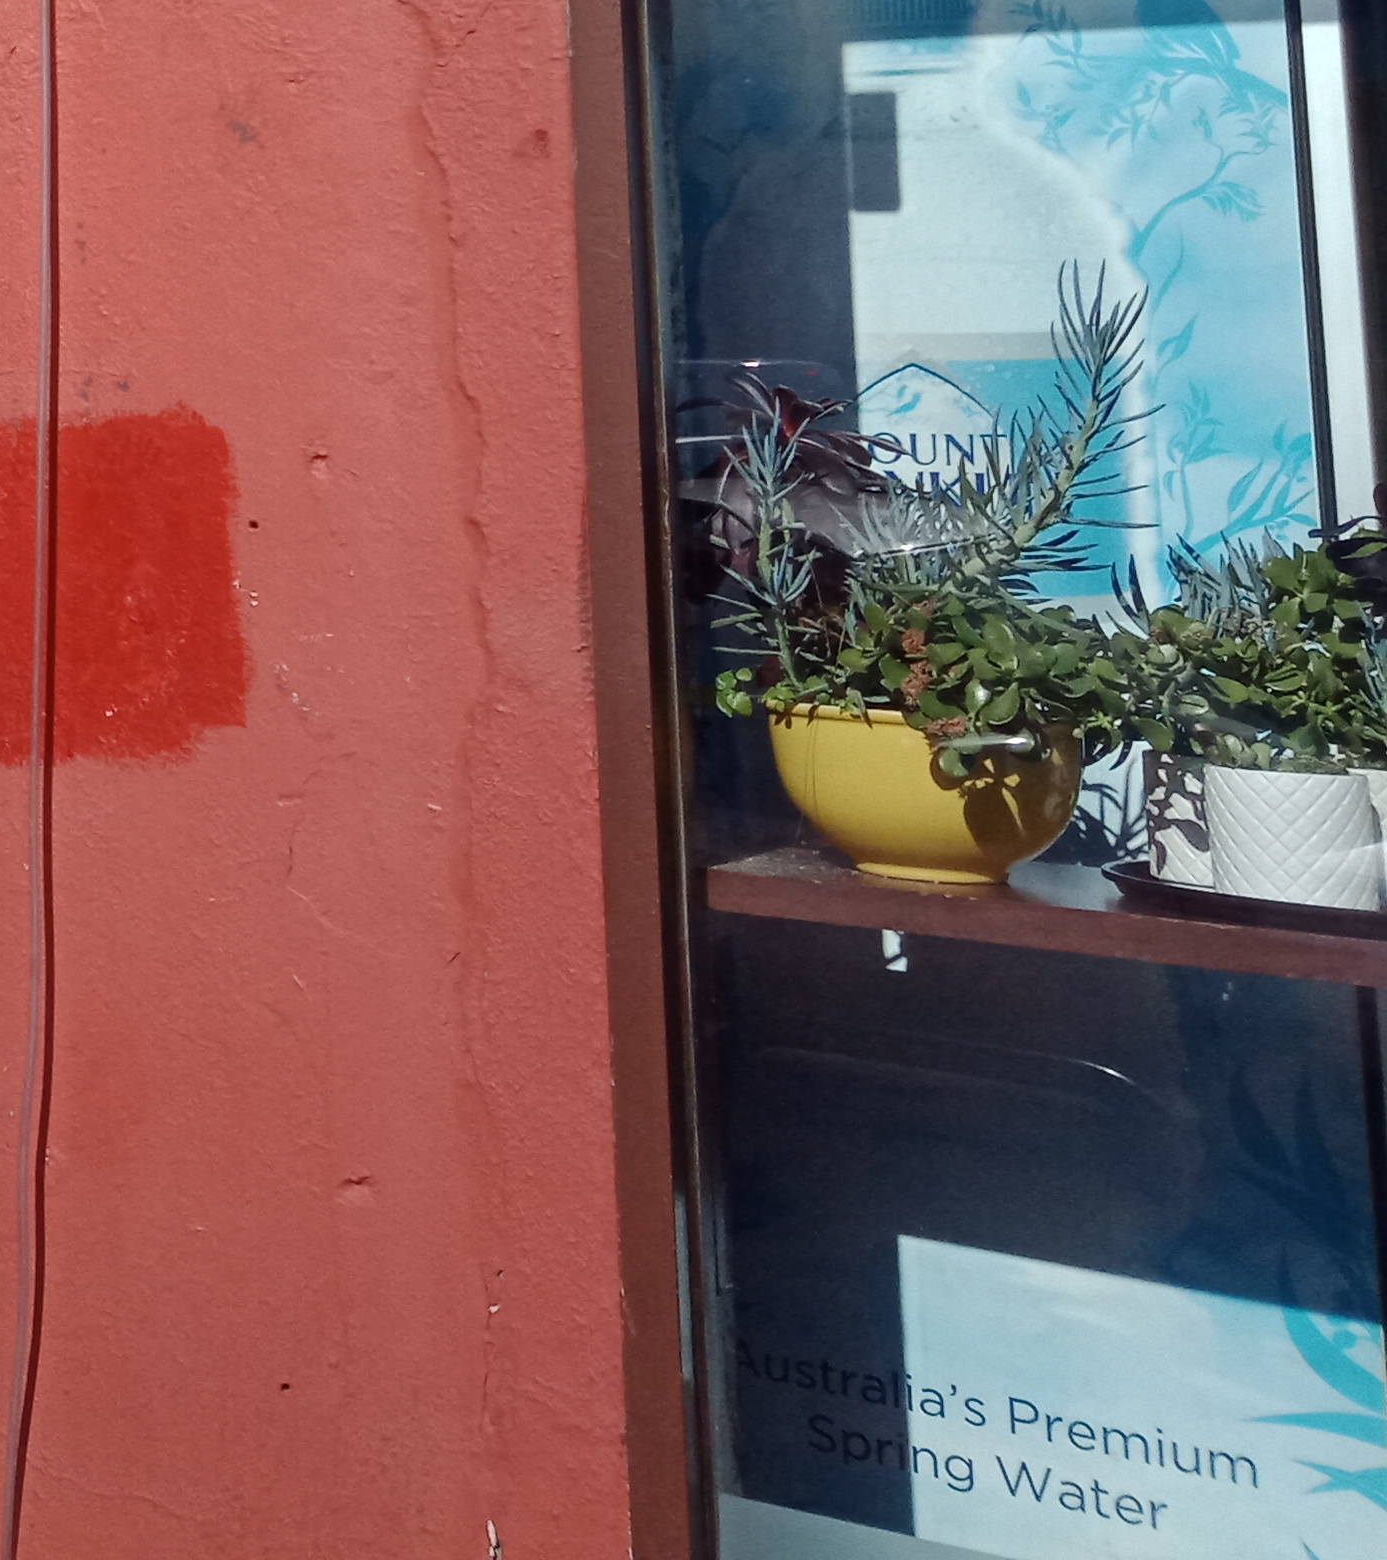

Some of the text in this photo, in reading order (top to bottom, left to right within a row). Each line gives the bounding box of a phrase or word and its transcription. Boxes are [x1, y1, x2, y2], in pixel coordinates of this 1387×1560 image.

[866, 431, 1008, 467] OUNT
[807, 1413, 1169, 1530] Spring Water
[1007, 1396, 1260, 1489] Premium
